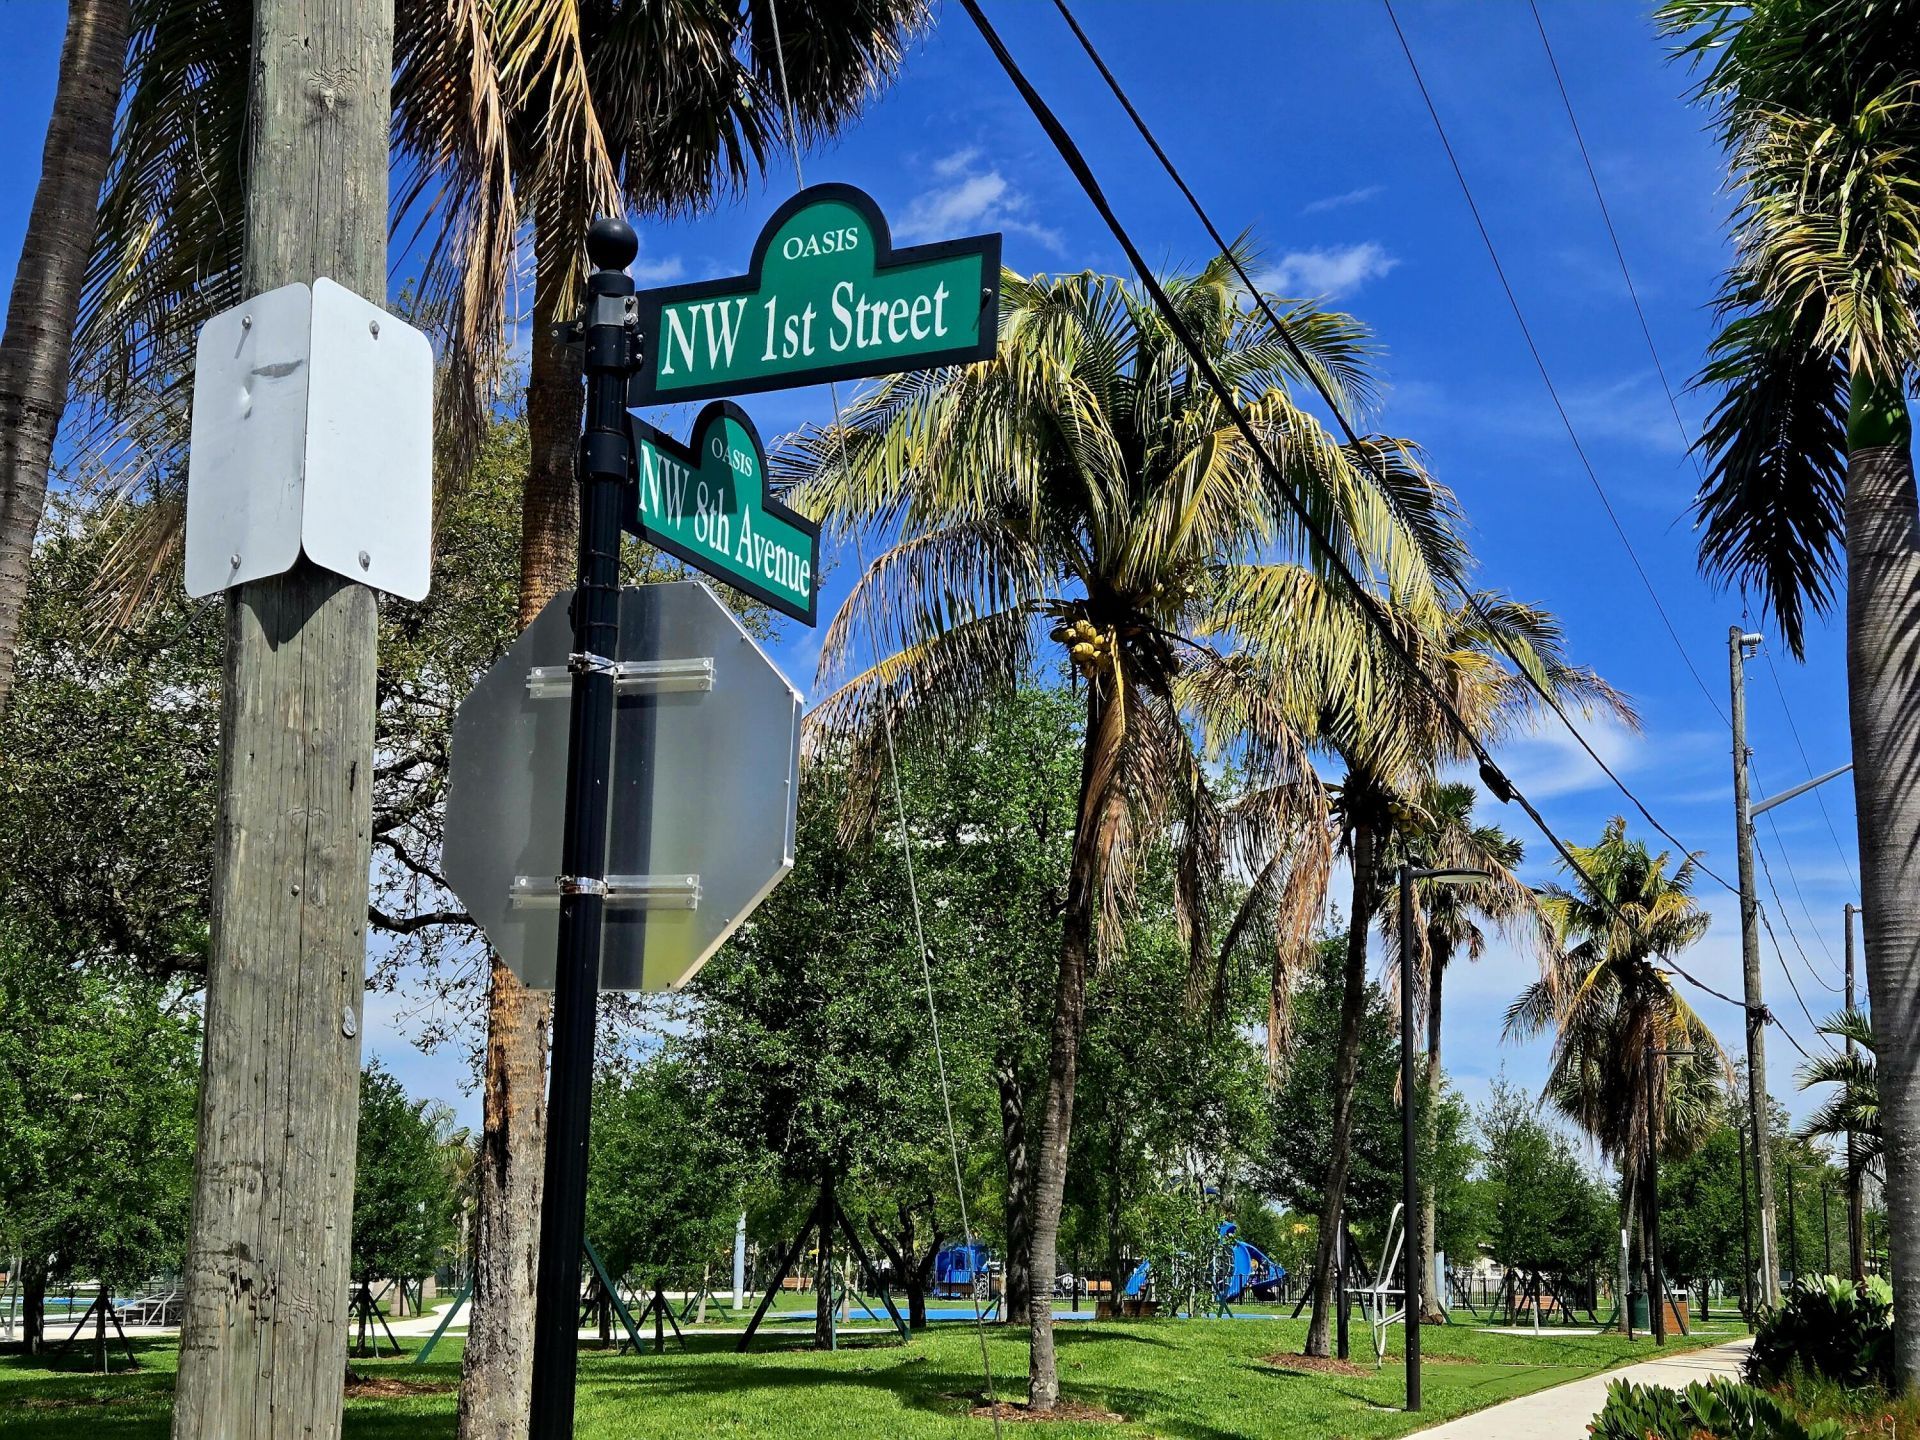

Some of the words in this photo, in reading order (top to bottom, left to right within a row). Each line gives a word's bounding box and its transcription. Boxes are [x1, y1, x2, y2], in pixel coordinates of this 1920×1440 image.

[783, 227, 858, 260] OASIS
[661, 297, 747, 375] NW
[761, 295, 817, 361] 1st
[829, 281, 949, 352] Street
[711, 437, 752, 477] OASIS
[639, 444, 690, 531] NW
[694, 481, 730, 556] 8th
[735, 504, 811, 597] Avenue
